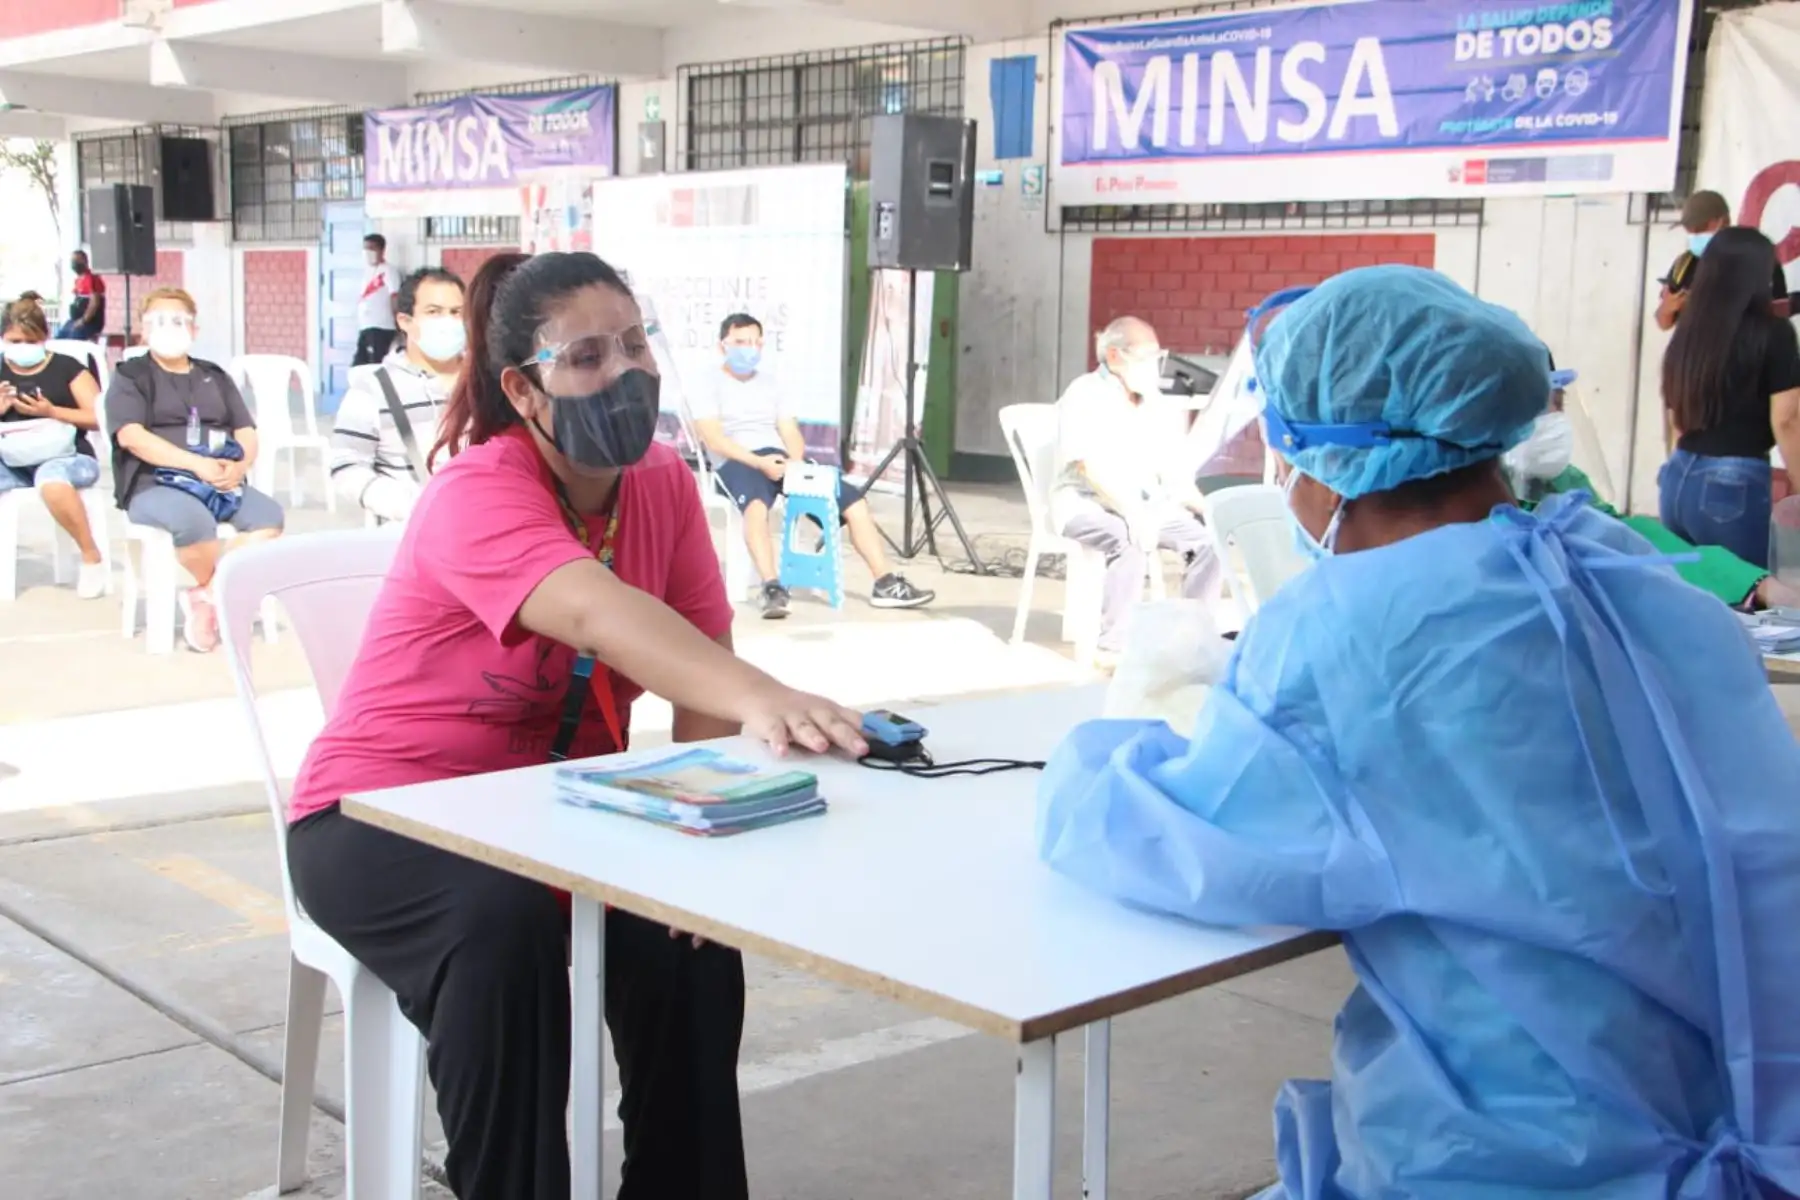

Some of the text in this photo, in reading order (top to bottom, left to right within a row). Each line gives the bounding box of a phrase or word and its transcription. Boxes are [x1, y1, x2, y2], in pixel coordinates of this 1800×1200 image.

[1454, 17, 1613, 61] DE TODOS
[1457, 11, 1477, 31] LA
[1481, 8, 1533, 29] SALUD
[1093, 37, 1400, 150] MINSA
[1515, 115, 1533, 129] DE
[1535, 114, 1553, 129] LA
[1555, 111, 1618, 127] COVID-19
[377, 115, 510, 184] MINSA
